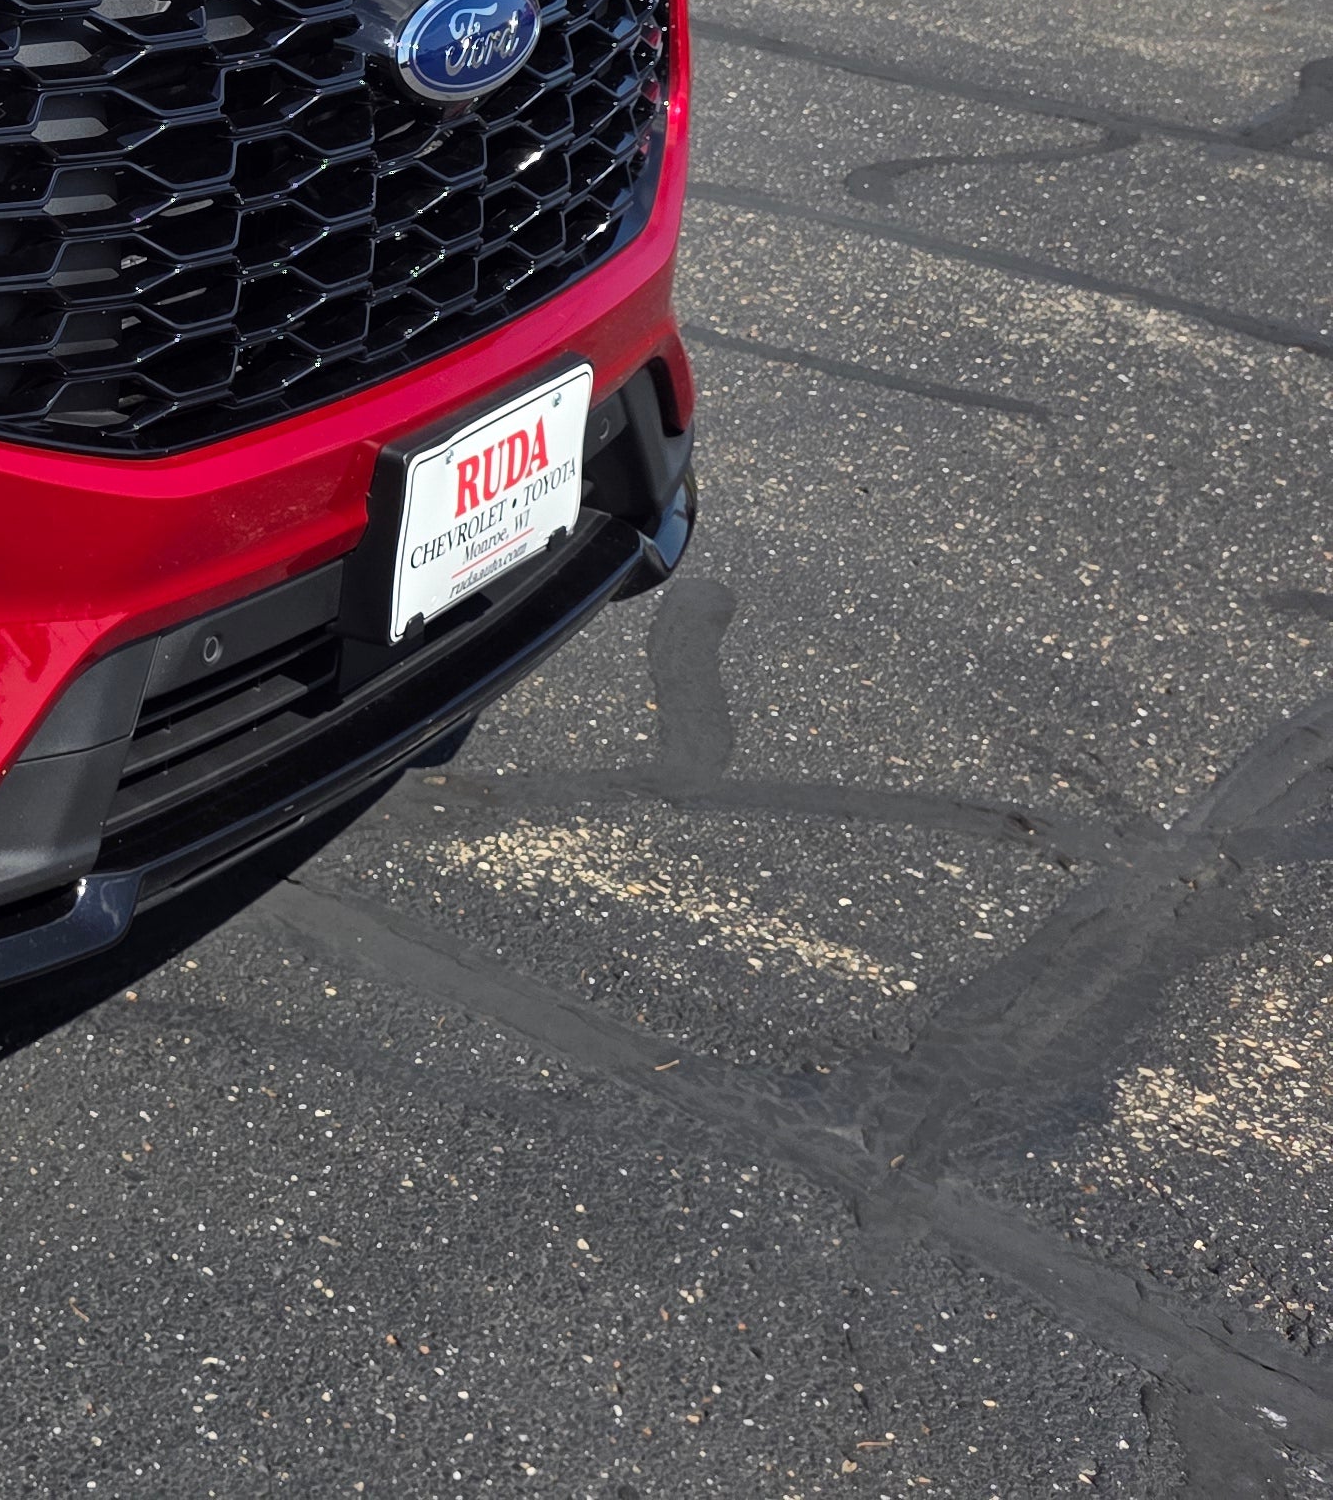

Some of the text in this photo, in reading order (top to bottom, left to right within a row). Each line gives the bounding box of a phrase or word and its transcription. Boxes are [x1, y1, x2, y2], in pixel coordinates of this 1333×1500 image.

[445, 2, 520, 77] Ford
[454, 415, 549, 519] RUDA
[410, 457, 577, 569] CHEVROLET TOYOTA
[513, 509, 532, 533] WI
